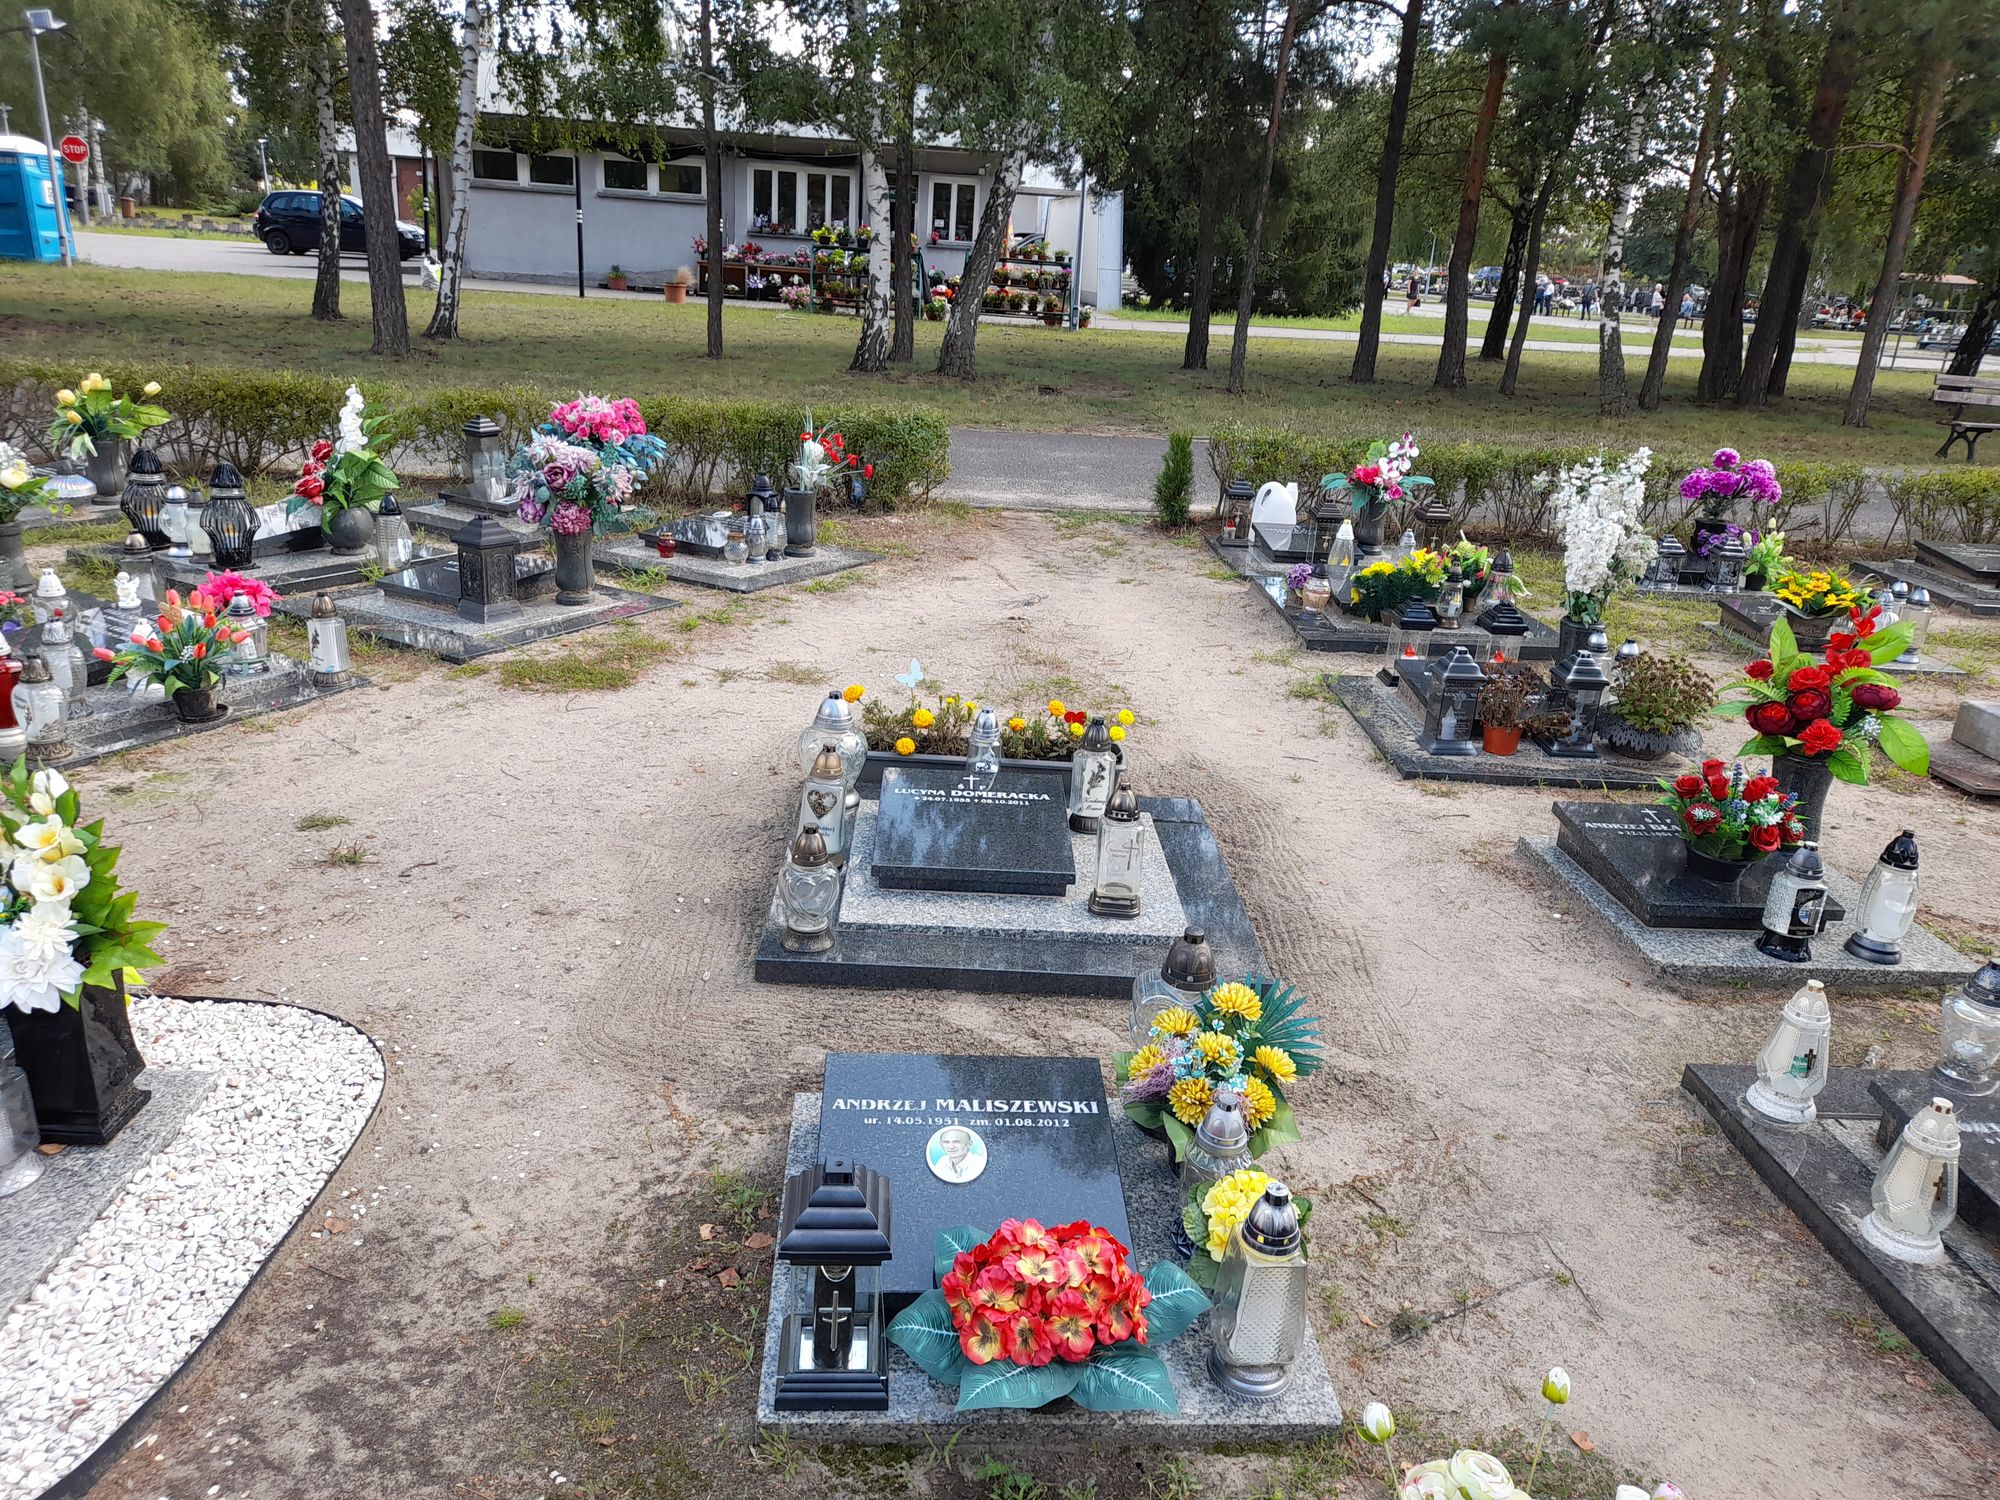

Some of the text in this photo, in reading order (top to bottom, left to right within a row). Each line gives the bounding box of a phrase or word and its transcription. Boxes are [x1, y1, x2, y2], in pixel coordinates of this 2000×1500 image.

[63, 144, 86, 154] STOP
[894, 788, 1051, 801] LUCYNA DOMERACKA
[1584, 822, 1646, 830] ANDRZEJ
[832, 1098, 1100, 1114] ANDRZEJ MALISZEWSKI
[863, 1117, 882, 1125] ur.
[886, 1116, 960, 1126] 14.05.1951
[994, 1118, 1070, 1127] 01.08.2012
